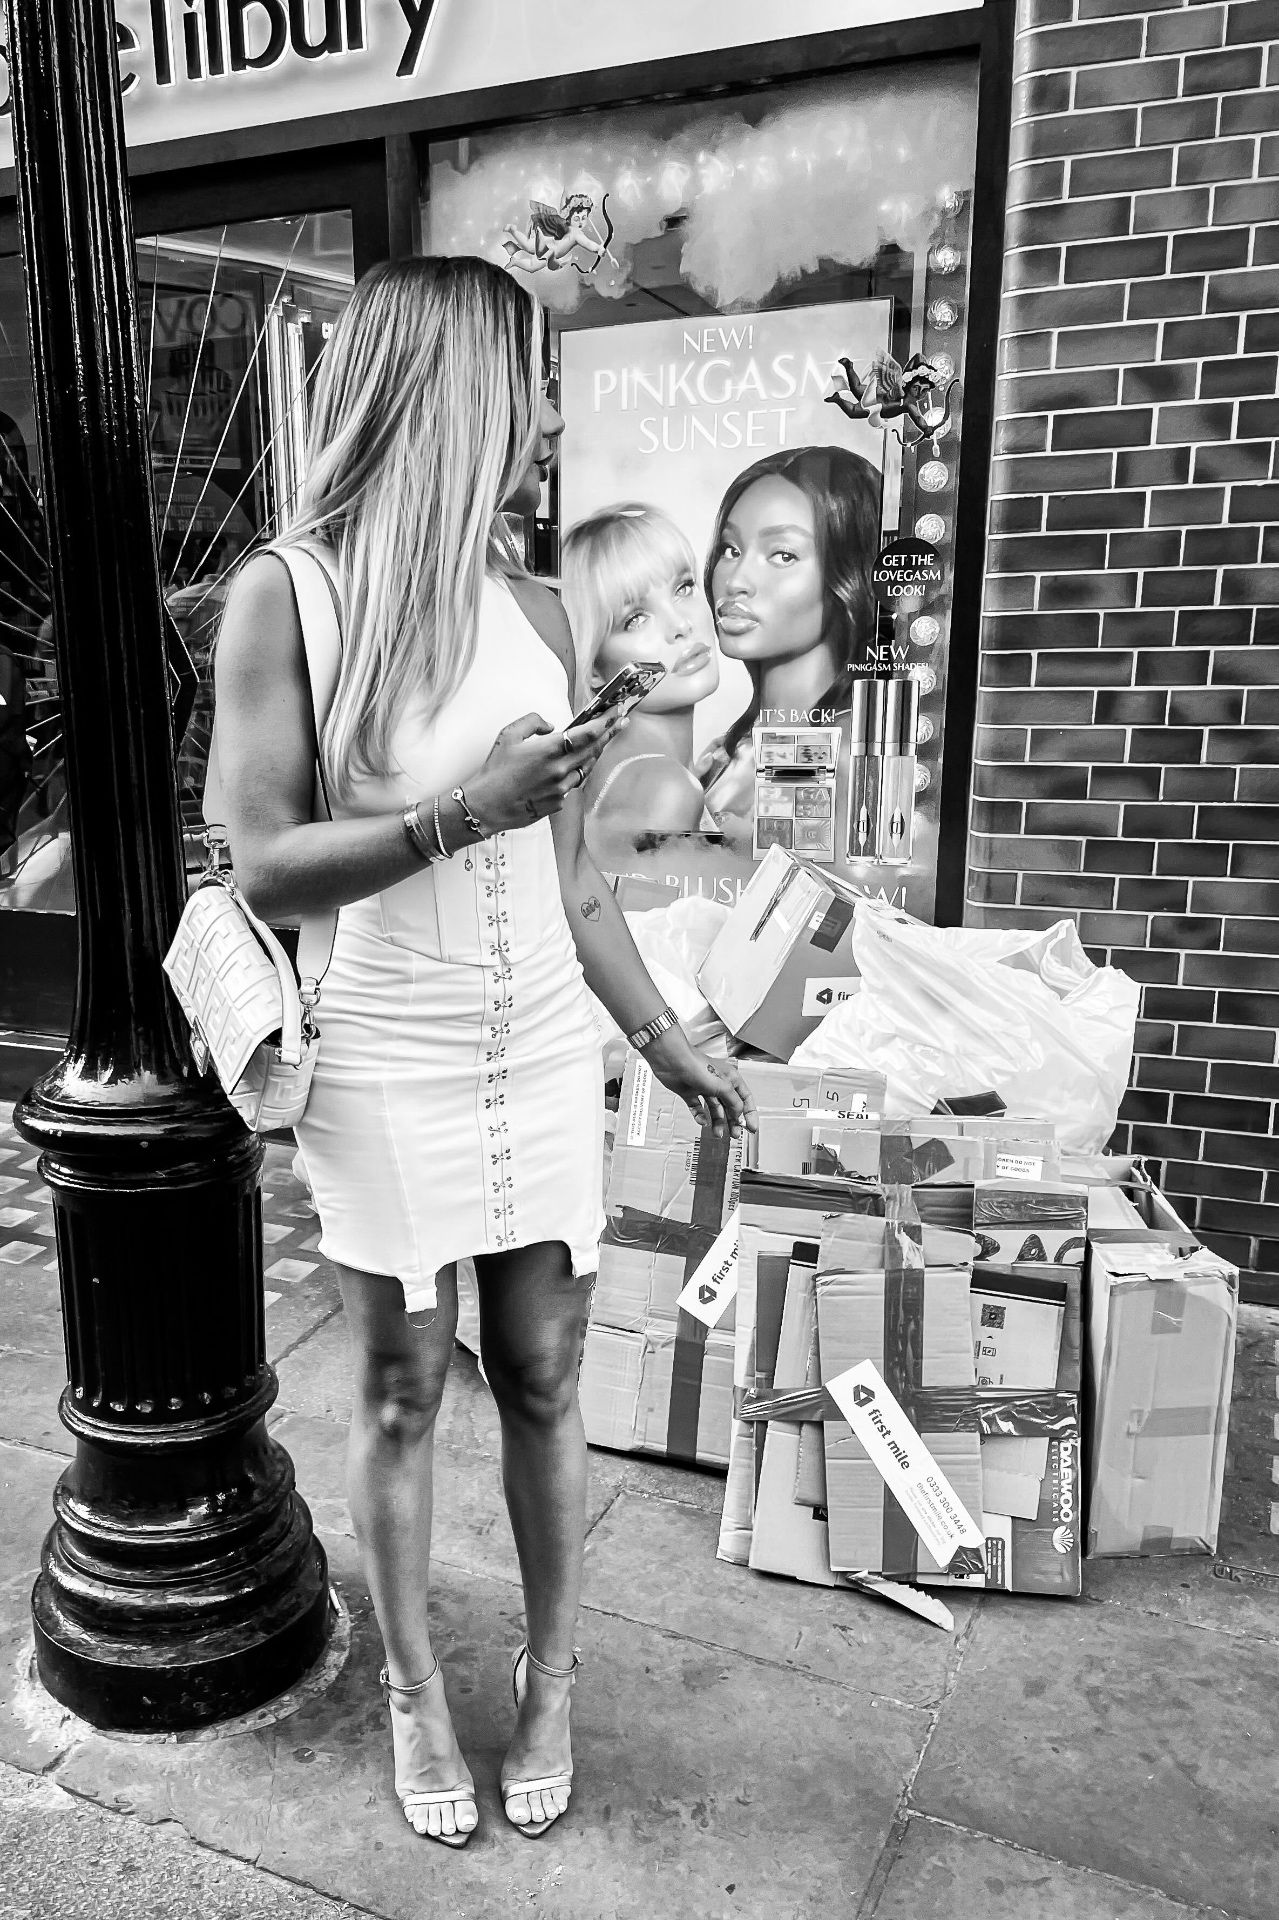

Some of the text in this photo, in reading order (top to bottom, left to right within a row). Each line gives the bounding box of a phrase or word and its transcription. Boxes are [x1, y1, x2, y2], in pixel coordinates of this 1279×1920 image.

[683, 325, 753, 354] NEW!
[639, 407, 796, 454] SUNSET
[882, 554, 934, 566] GET THE
[873, 569, 941, 582] LOVEGASM
[887, 584, 926, 597] LOOK!
[866, 645, 909, 661] NEW
[847, 662, 891, 672] PINKGASM
[759, 708, 836, 723] IT'S BACK!
[711, 1259, 733, 1285] first
[867, 1408, 910, 1471] first mile
[1060, 1441, 1074, 1523] DAEWOO
[926, 1476, 943, 1498] 0333
[939, 1496, 952, 1514] 300
[949, 1513, 967, 1535] 3448
